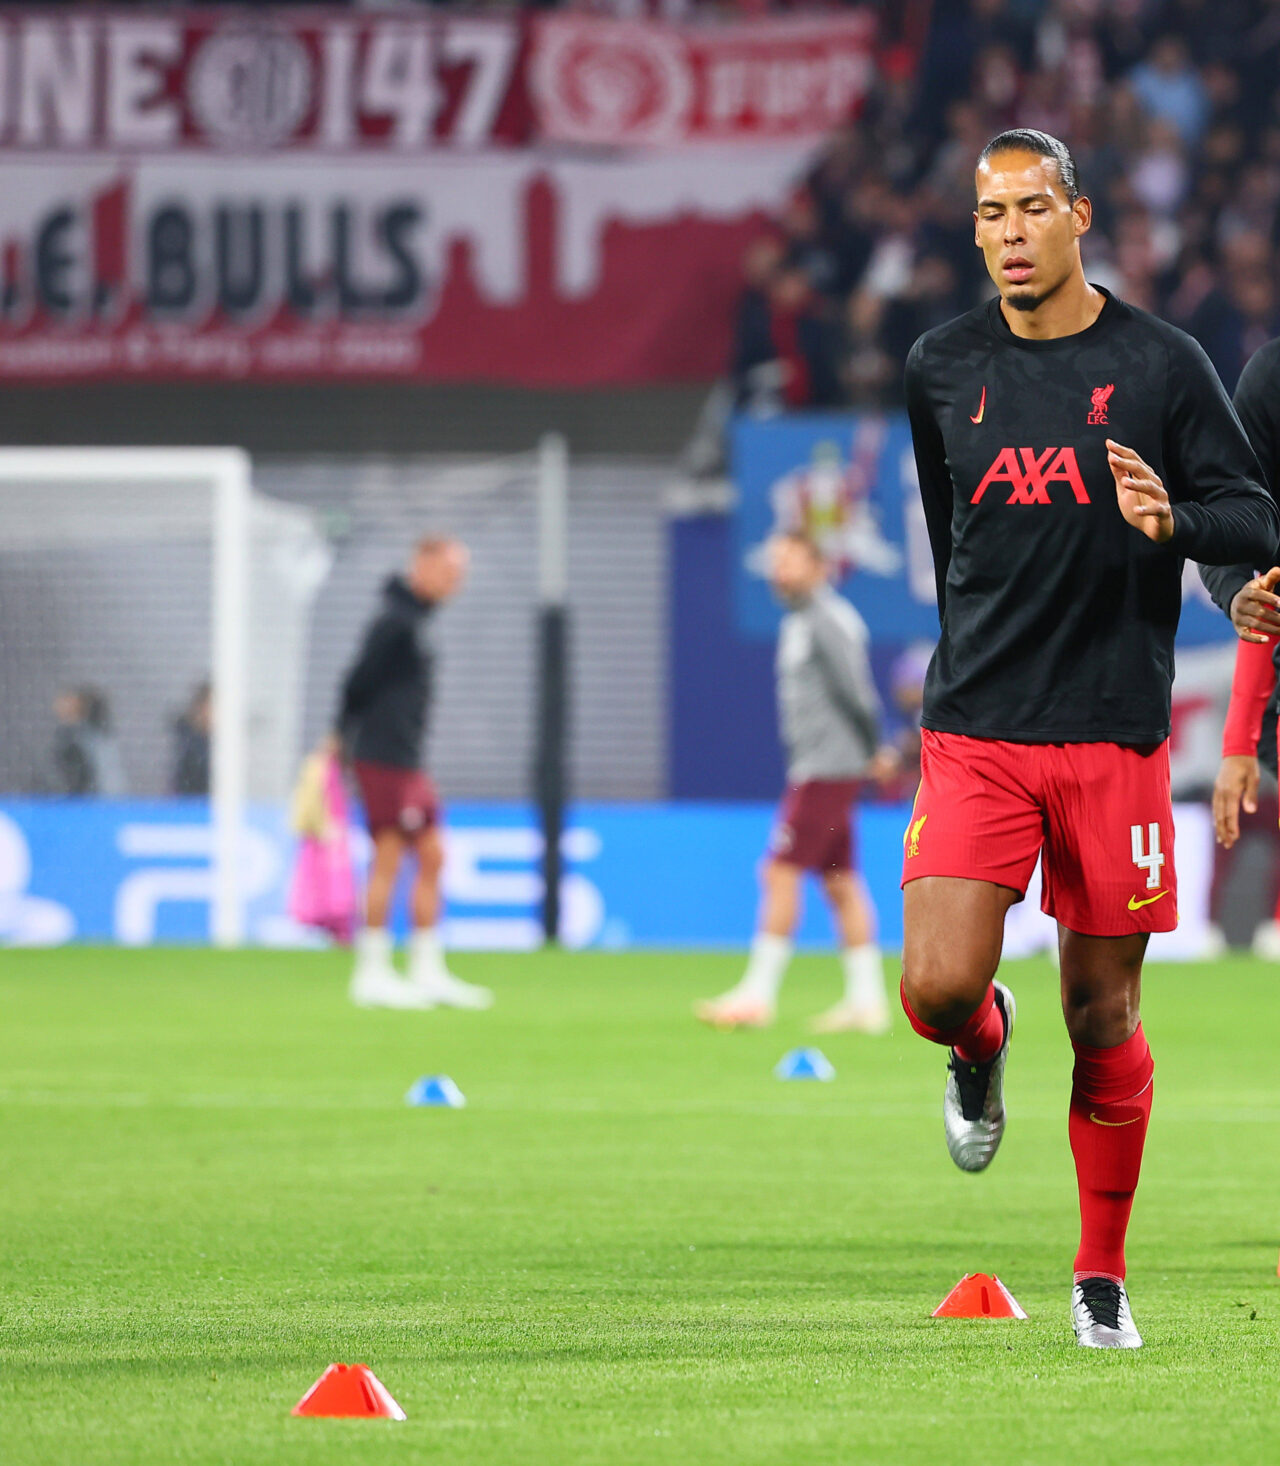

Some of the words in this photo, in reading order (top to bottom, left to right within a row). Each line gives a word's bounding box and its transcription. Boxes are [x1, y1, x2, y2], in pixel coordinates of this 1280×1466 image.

[0, 16, 182, 146] NE
[143, 197, 428, 312] BULLS
[970, 447, 1091, 504] AXA
[1130, 822, 1165, 889] 4
